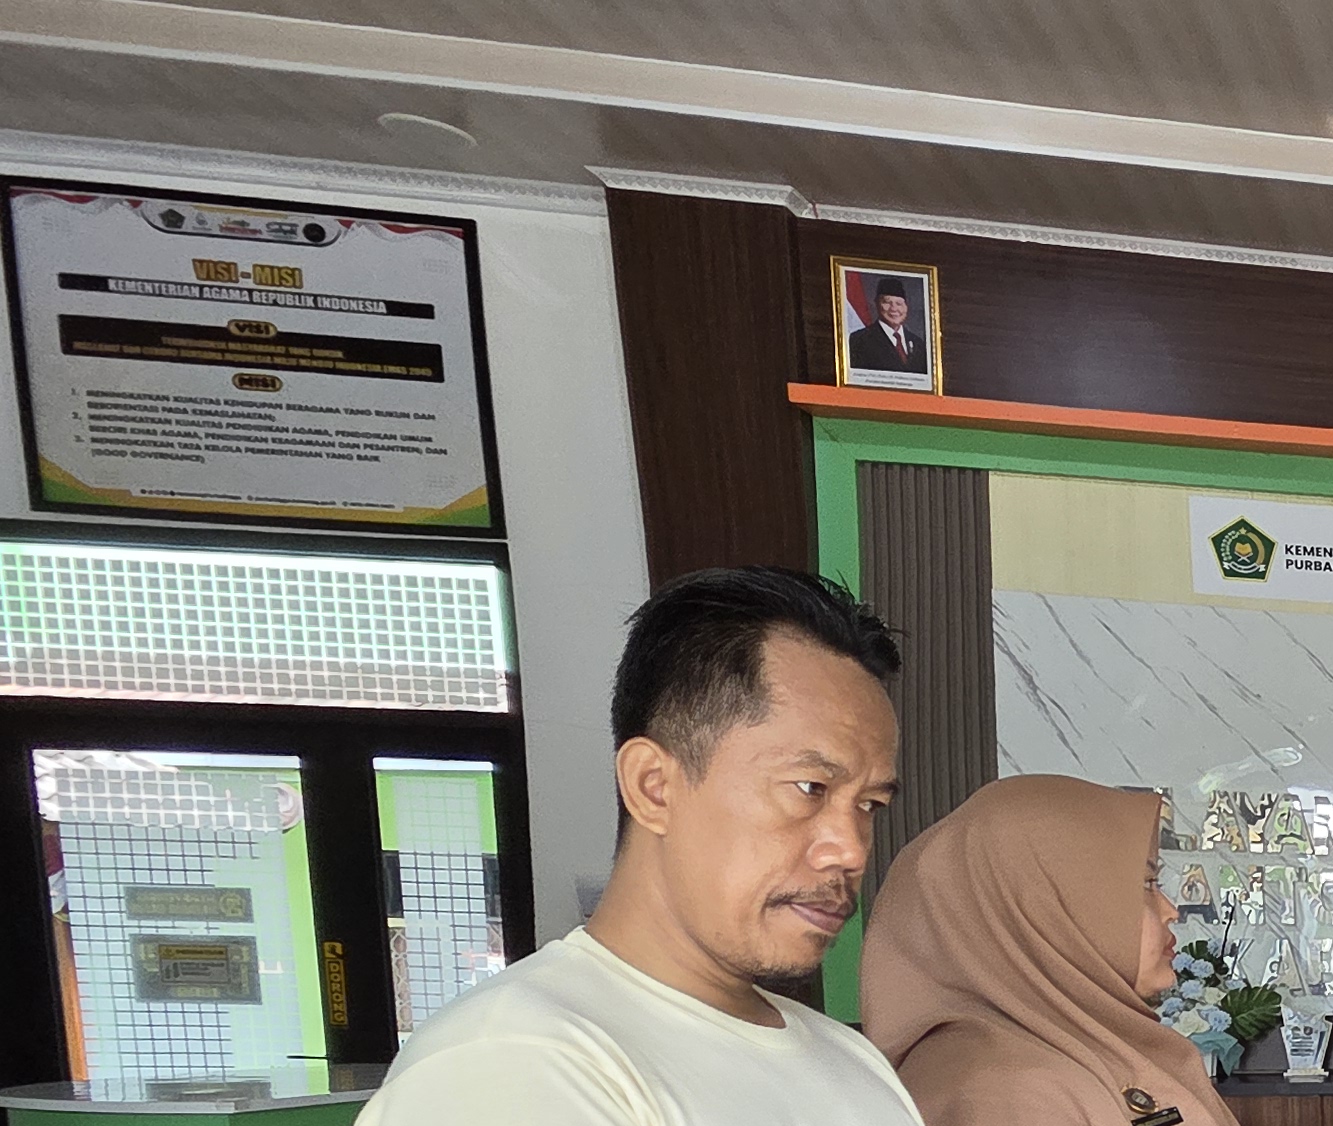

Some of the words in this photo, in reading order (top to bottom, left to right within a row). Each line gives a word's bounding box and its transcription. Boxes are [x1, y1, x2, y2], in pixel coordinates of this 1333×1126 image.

[192, 259, 239, 283] VISI
[252, 264, 303, 288] MISI
[108, 278, 200, 299] KEMENTERIAN
[203, 286, 249, 303] AGAMA
[252, 290, 315, 308] REPUBLIK
[318, 296, 388, 315] INDONESIA
[234, 322, 271, 336] VISI
[330, 962, 346, 1022] DORONG
